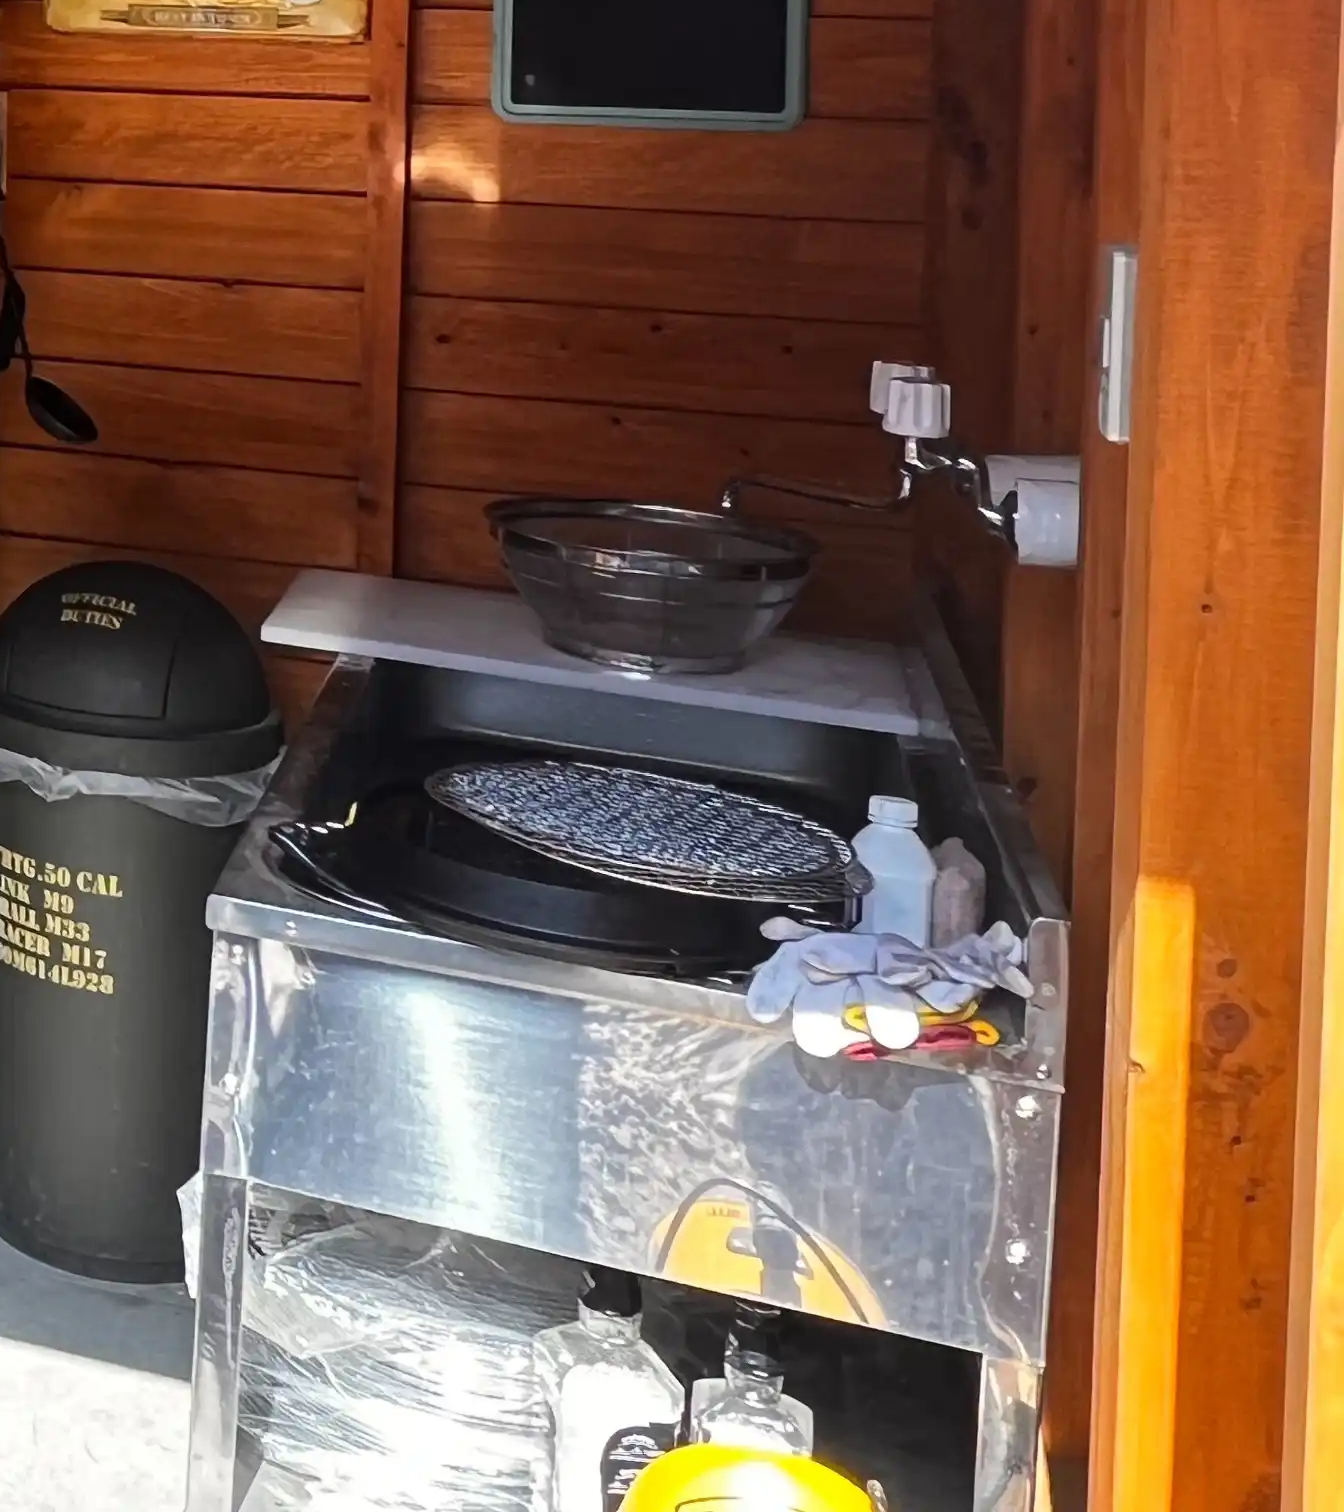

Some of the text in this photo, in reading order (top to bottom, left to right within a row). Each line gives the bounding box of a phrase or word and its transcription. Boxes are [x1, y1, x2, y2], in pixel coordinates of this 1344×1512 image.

[60, 592, 137, 616] OFFICIAL
[60, 608, 124, 630] DUTIES
[76, 871, 124, 898] CAL
[43, 889, 75, 914] M9
[44, 913, 90, 942] M33
[61, 941, 108, 970] M17
